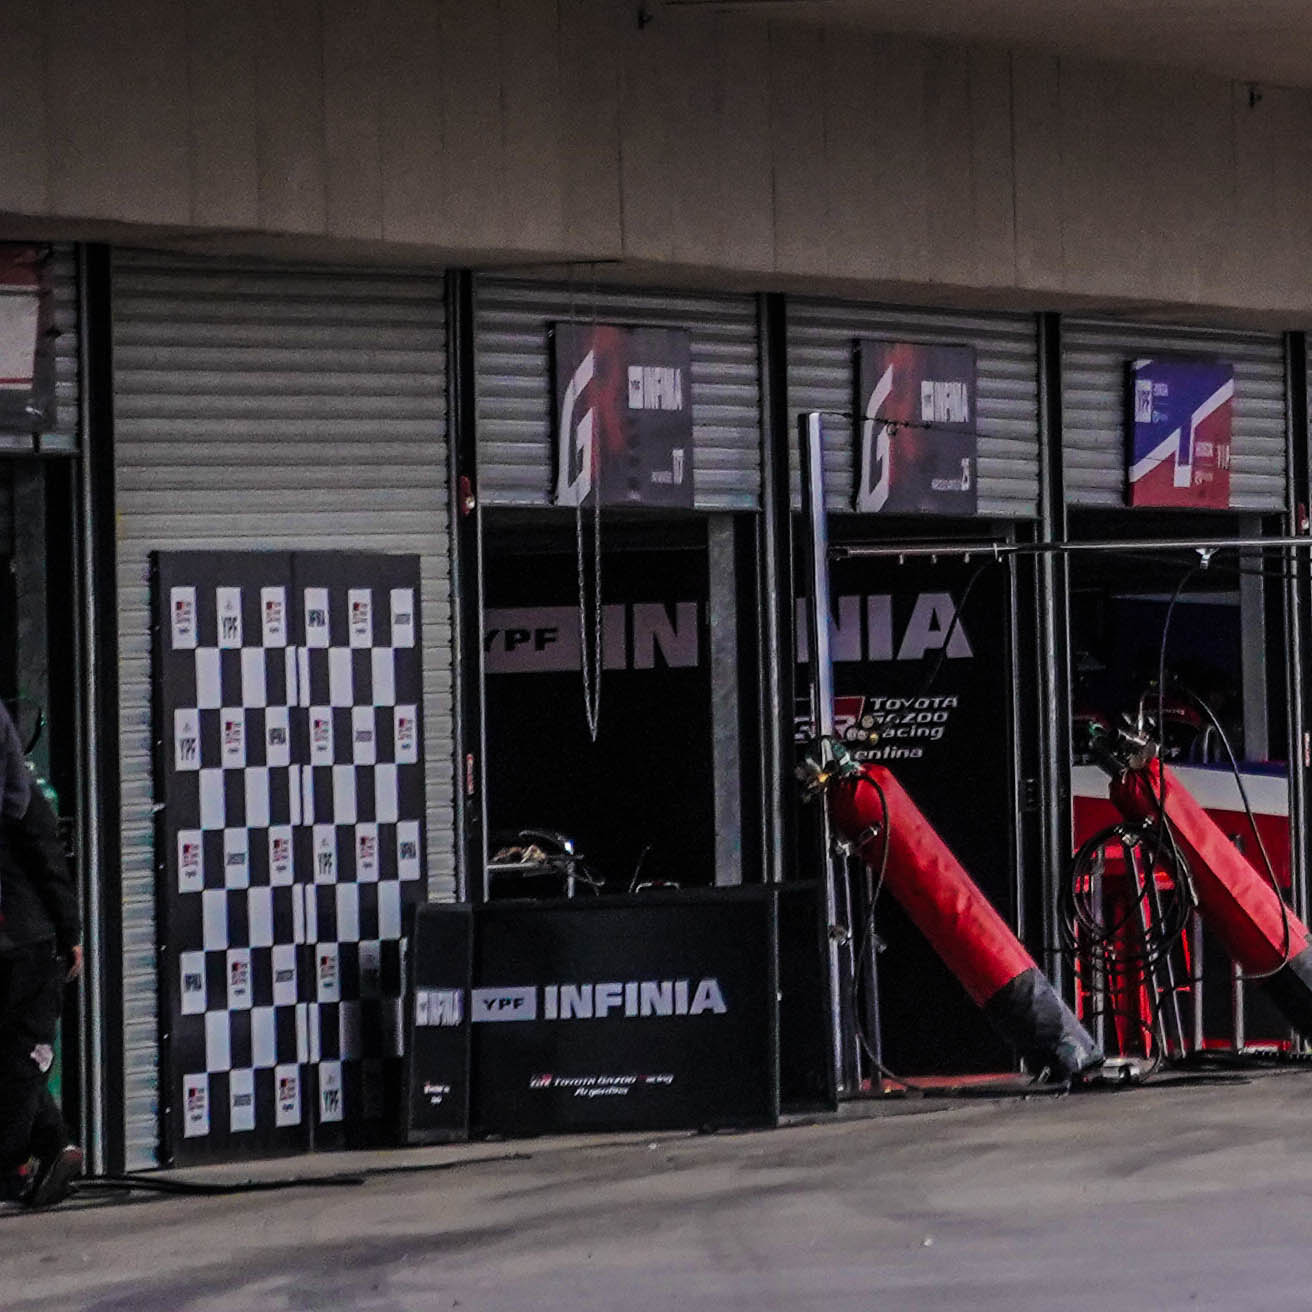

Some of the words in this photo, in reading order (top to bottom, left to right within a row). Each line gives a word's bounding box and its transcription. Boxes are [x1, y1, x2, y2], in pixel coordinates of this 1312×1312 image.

[870, 696, 959, 710] TOYOTA
[881, 725, 946, 741] acing
[482, 997, 525, 1011] YPF
[544, 978, 728, 1021] INFINIA
